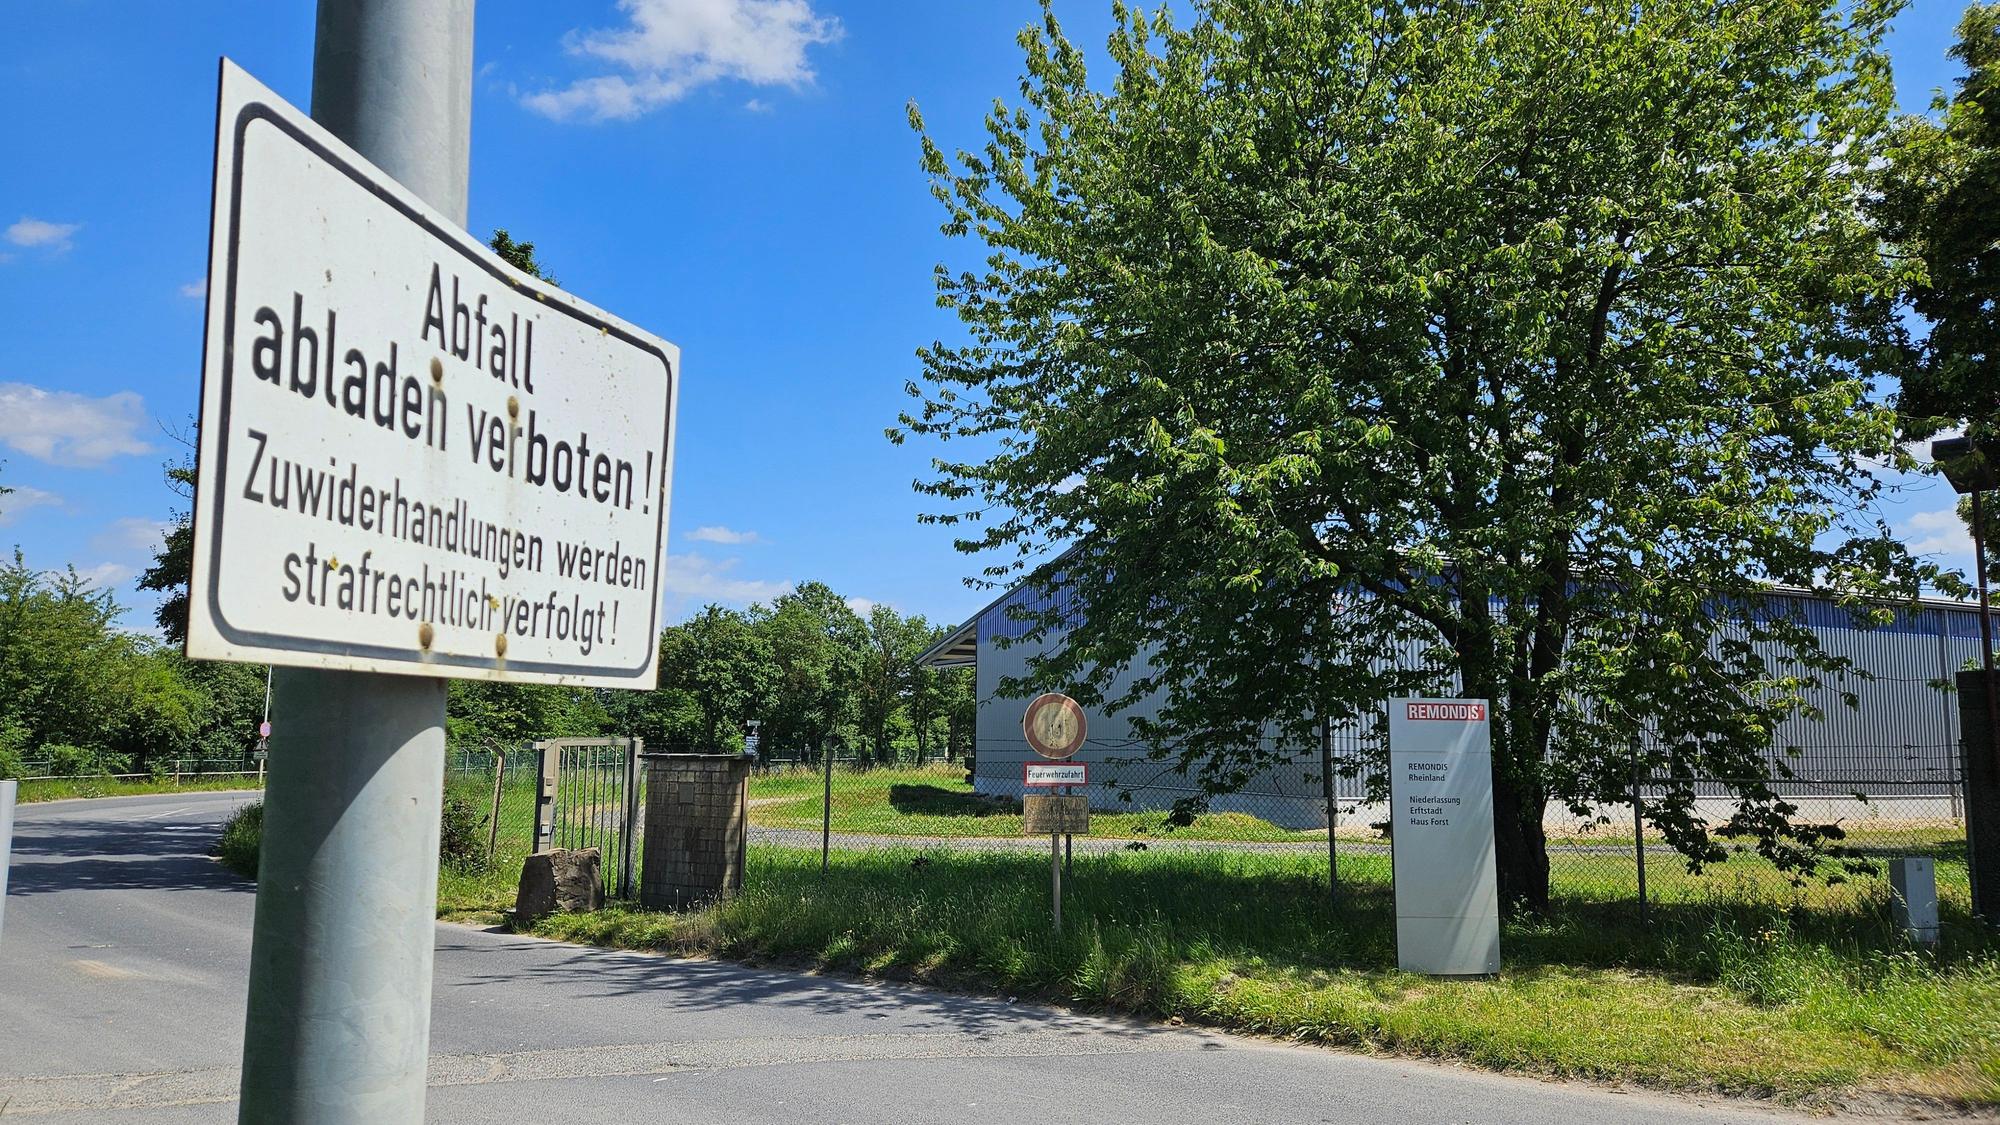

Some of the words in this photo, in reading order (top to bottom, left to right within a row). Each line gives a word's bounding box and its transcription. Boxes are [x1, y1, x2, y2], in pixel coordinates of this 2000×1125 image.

[421, 261, 535, 395] Abfall
[251, 291, 448, 452] abladen
[243, 428, 543, 581] Zuwiderhandlungen
[556, 538, 647, 591] werden
[281, 542, 493, 633] strafrechtlich
[502, 590, 620, 656] verfolgt!
[1408, 763, 1448, 771] REMONDIS
[1028, 769, 1084, 779] Feuerwehrzufahrt
[1408, 773, 1445, 781] Rheinland
[1409, 795, 1461, 805] Niederlassung
[1410, 806, 1443, 815] Erftstadt
[1410, 817, 1429, 825] Haus
[1430, 817, 1449, 825] Forst
